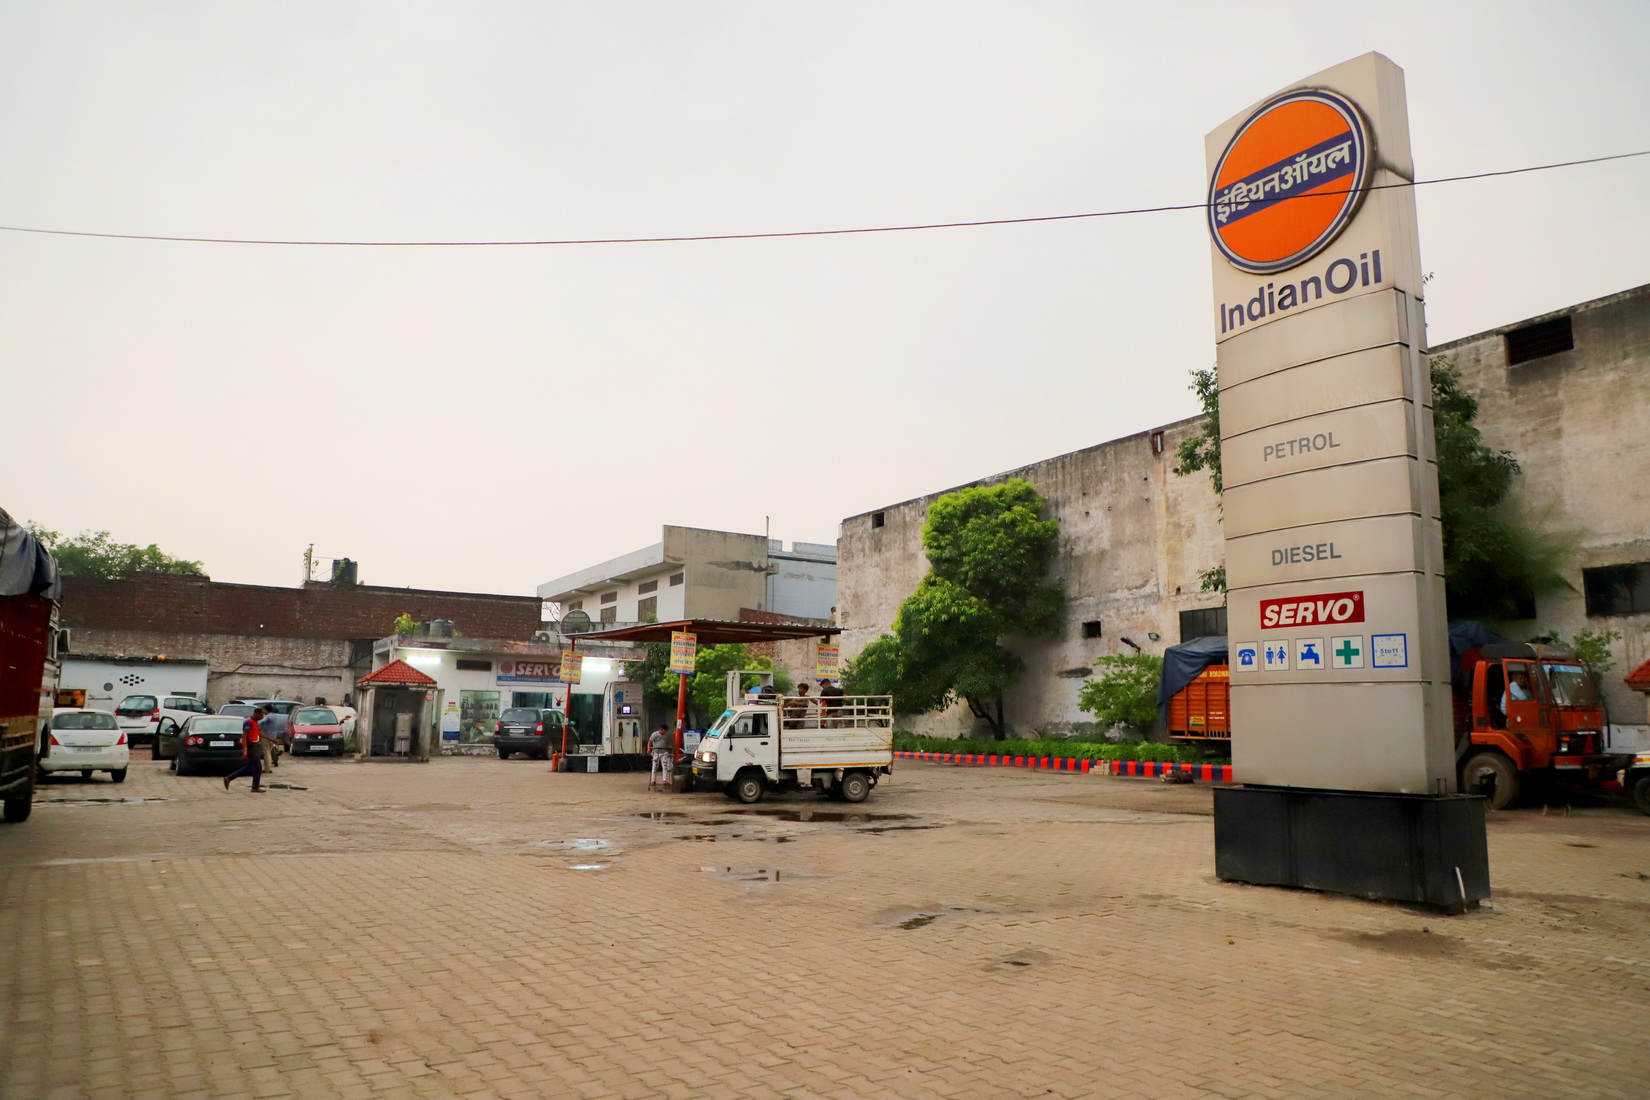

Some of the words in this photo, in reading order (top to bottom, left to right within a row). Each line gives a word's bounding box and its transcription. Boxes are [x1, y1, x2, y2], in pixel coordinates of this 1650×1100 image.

[1221, 249, 1382, 334] IndianOil
[1263, 432, 1341, 462] PETROL
[1271, 542, 1342, 566] DIESEL
